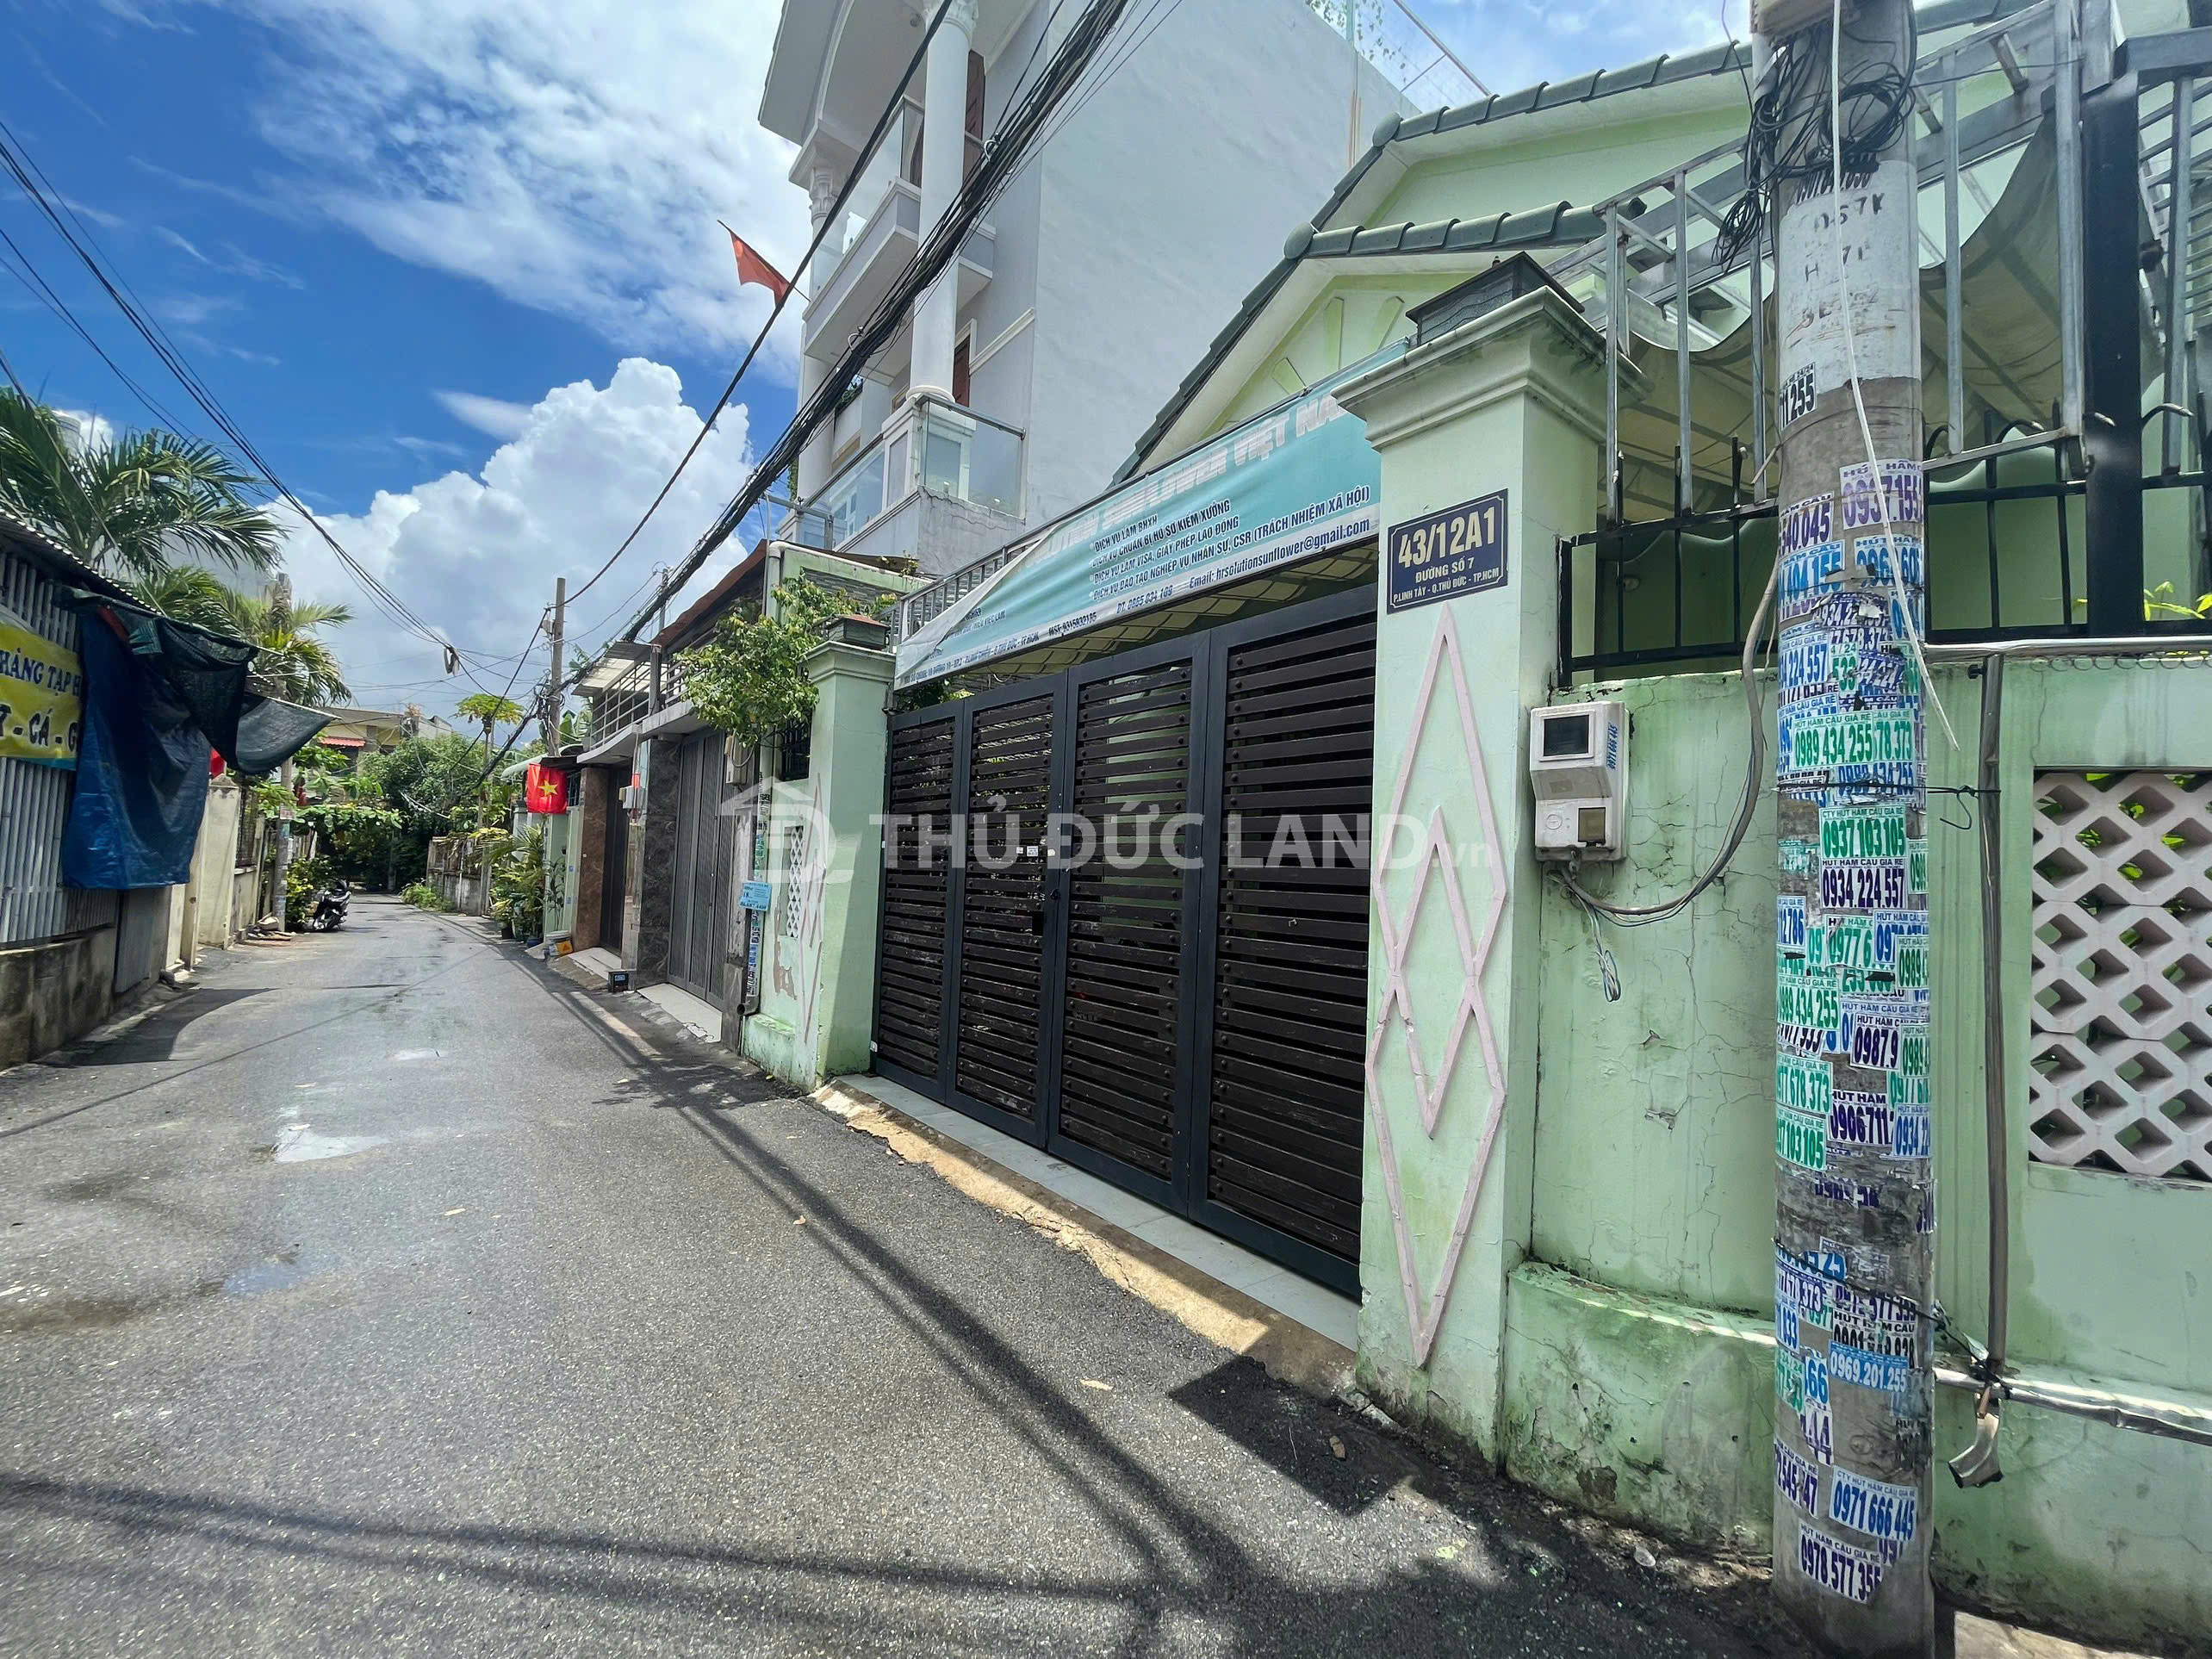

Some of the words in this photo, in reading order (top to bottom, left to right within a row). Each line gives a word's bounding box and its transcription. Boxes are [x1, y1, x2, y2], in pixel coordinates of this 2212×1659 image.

[1296, 394, 1346, 438] NA
[1095, 538, 1110, 552] DỊCH
[1191, 544, 1215, 563] NHÂN
[1233, 530, 1252, 549] CSR
[1291, 502, 1326, 527] NHIỆM
[1328, 494, 1343, 513] XÃ
[1398, 506, 1495, 569] 43/12A1
[1094, 569, 1109, 584] DỊCH
[1175, 533, 1196, 552] PHÉP
[1197, 526, 1213, 542] LAO
[1215, 516, 1240, 536] ĐỘNG
[1190, 570, 1215, 589] Email:
[1216, 519, 1370, 581] hrsolutionsunflower@gmail.com
[1415, 565, 1449, 583] ĐƯỜNG
[1451, 556, 1465, 574] SỐ
[1468, 557, 1475, 569] 7
[1393, 590, 1414, 604] P.LINH
[1414, 586, 1426, 598] TÂY
[1432, 578, 1452, 593] Q.THỦ
[1452, 575, 1467, 587] ĐỨC
[1473, 568, 1499, 583] TP.HCM
[47, 665, 71, 697] TẠP
[28, 708, 53, 747] CÁ
[1794, 723, 1873, 767] 0989.434.255
[1823, 817, 1905, 858] 0937.103.105
[1823, 868, 1904, 908] 0934.224.557
[1830, 1351, 1907, 1393] 0969.201.255
[1833, 1480, 1915, 1542] 0971.666.445
